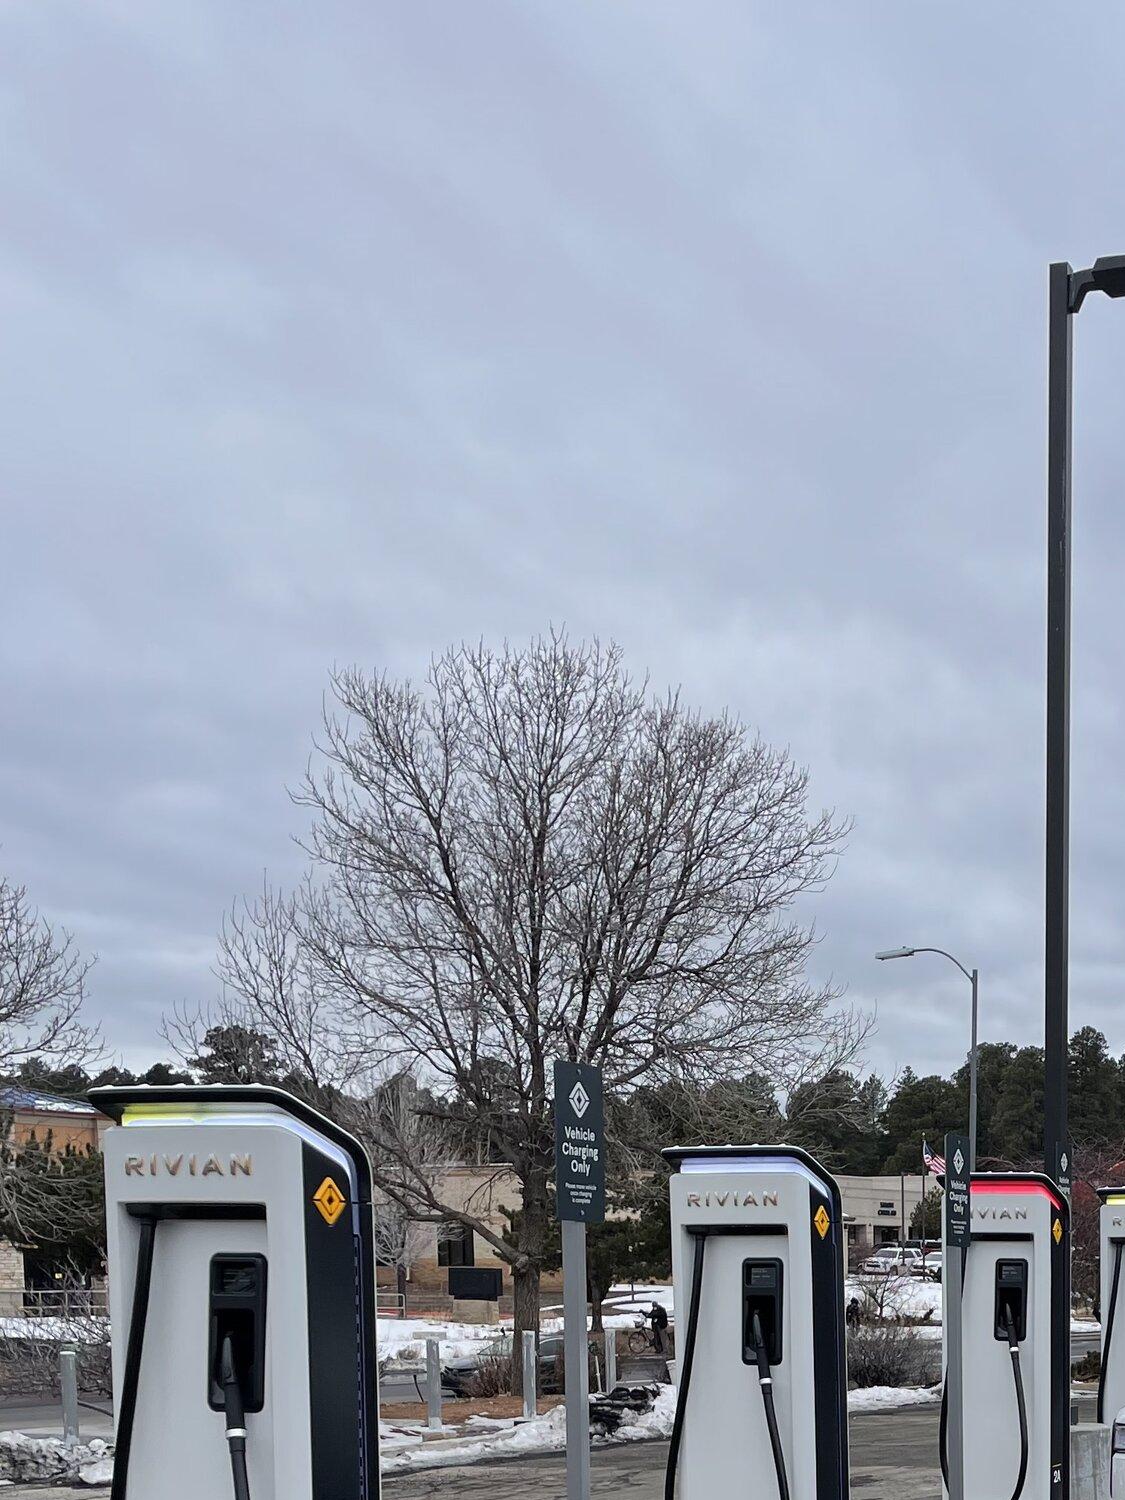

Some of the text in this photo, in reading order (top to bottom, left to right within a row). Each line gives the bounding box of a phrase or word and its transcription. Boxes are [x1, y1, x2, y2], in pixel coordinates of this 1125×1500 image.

[564, 1126, 596, 1141] Vehicle
[562, 1142, 599, 1161] Charging
[124, 1152, 252, 1176] RIVIAN
[571, 1160, 591, 1177] Only
[687, 1191, 779, 1207] RIVIAN
[970, 1207, 1028, 1220] IVIAN
